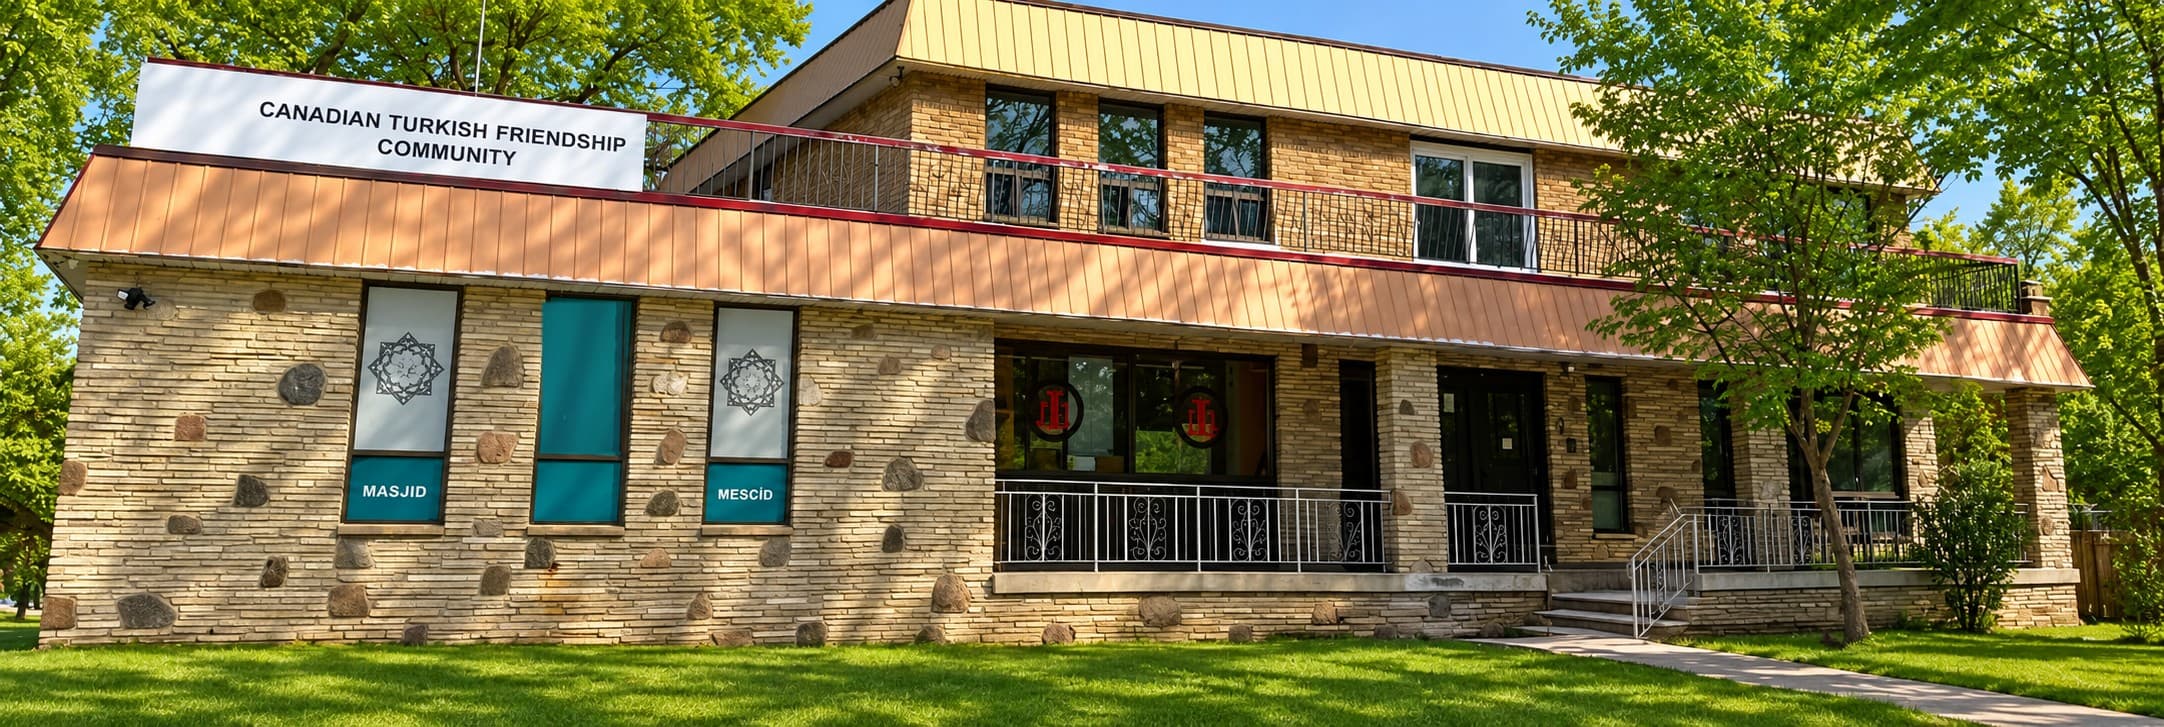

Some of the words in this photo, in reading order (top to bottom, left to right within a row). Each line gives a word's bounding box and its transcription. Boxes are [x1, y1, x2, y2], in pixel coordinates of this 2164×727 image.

[259, 101, 381, 129] CANADIAN
[388, 114, 488, 139] TURKISH
[496, 125, 626, 152] FRIENDSHIP
[377, 138, 517, 166] COMMUNITY
[362, 485, 427, 498] MASJID
